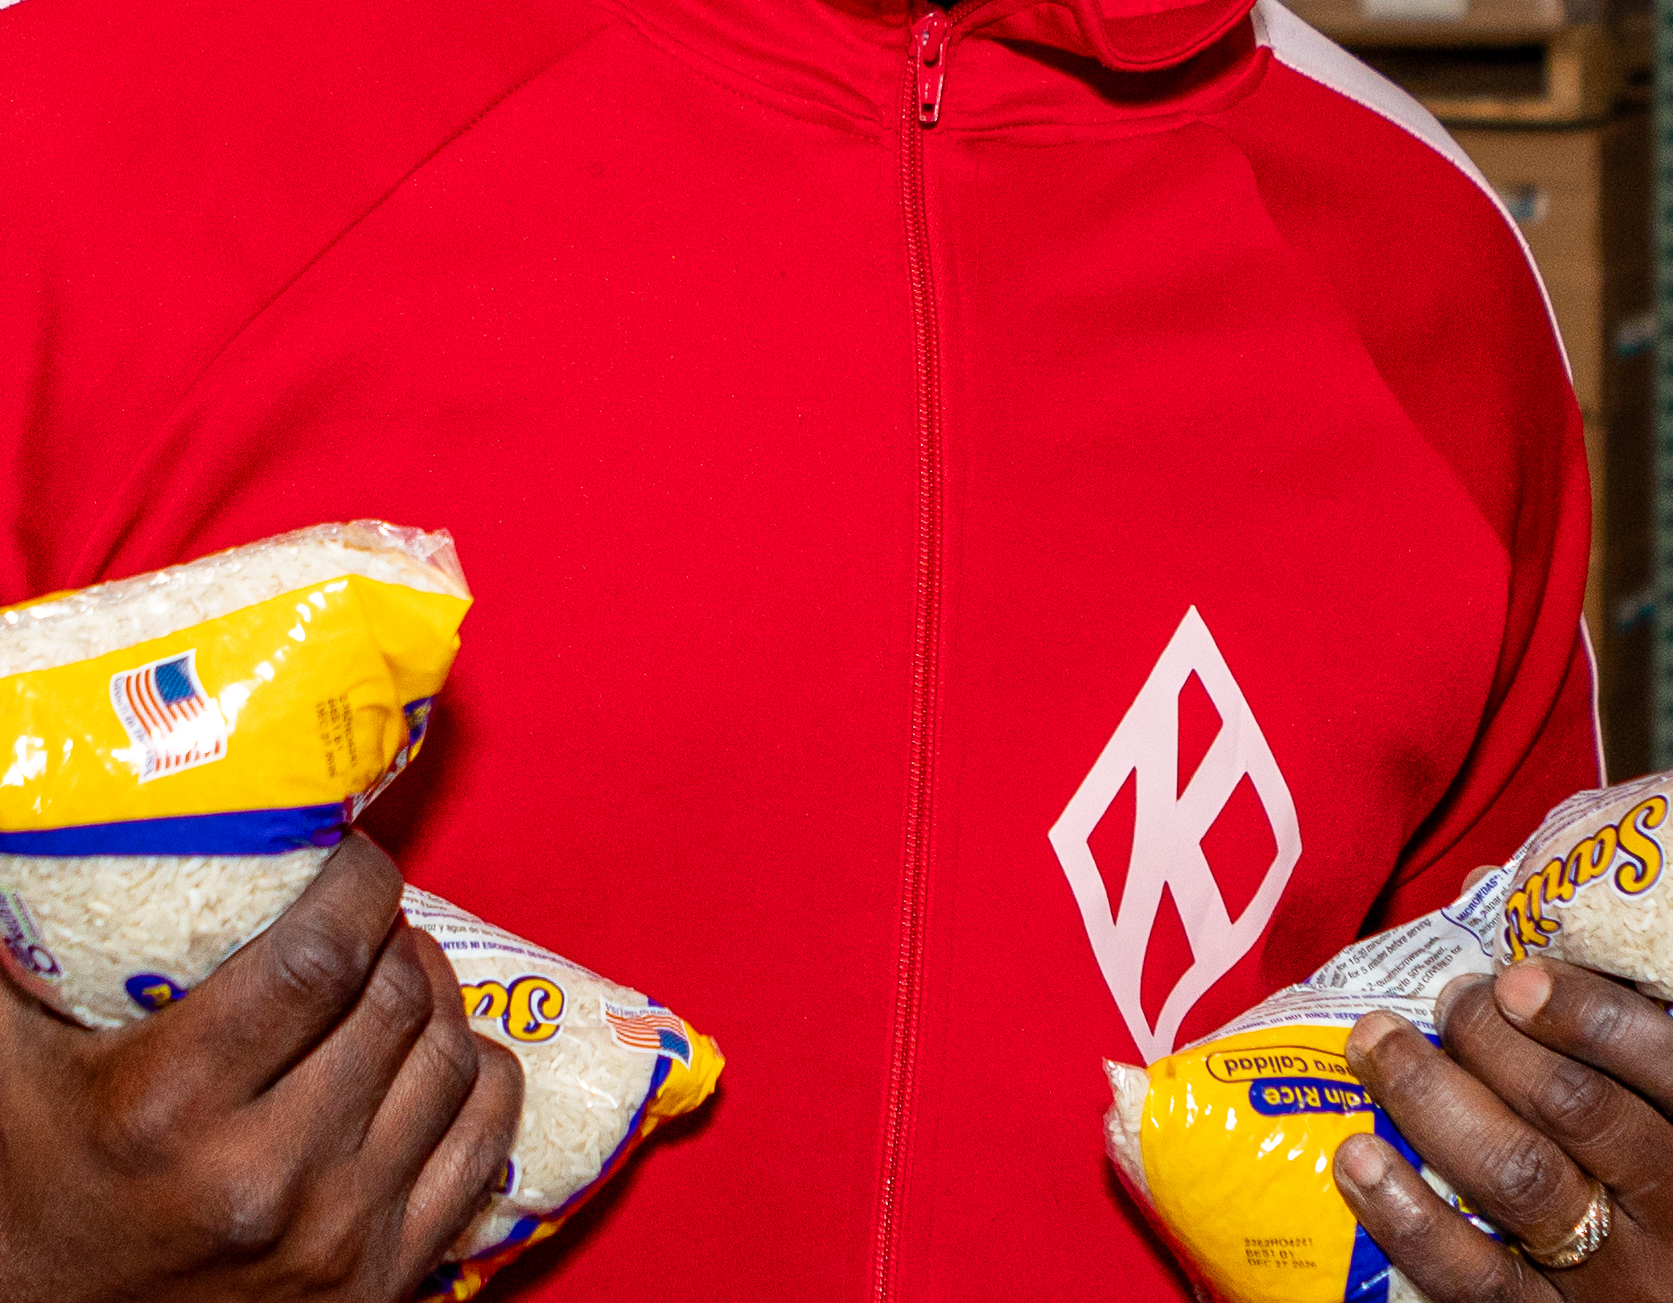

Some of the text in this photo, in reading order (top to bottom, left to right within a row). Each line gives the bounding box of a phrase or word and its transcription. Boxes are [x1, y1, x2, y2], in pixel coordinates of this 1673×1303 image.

[1224, 1055, 1309, 1078] Calidad
[1263, 1085, 1382, 1110] rain Rice
[1244, 1248, 1276, 1260] BEST
[1247, 1258, 1271, 1269] DEC
